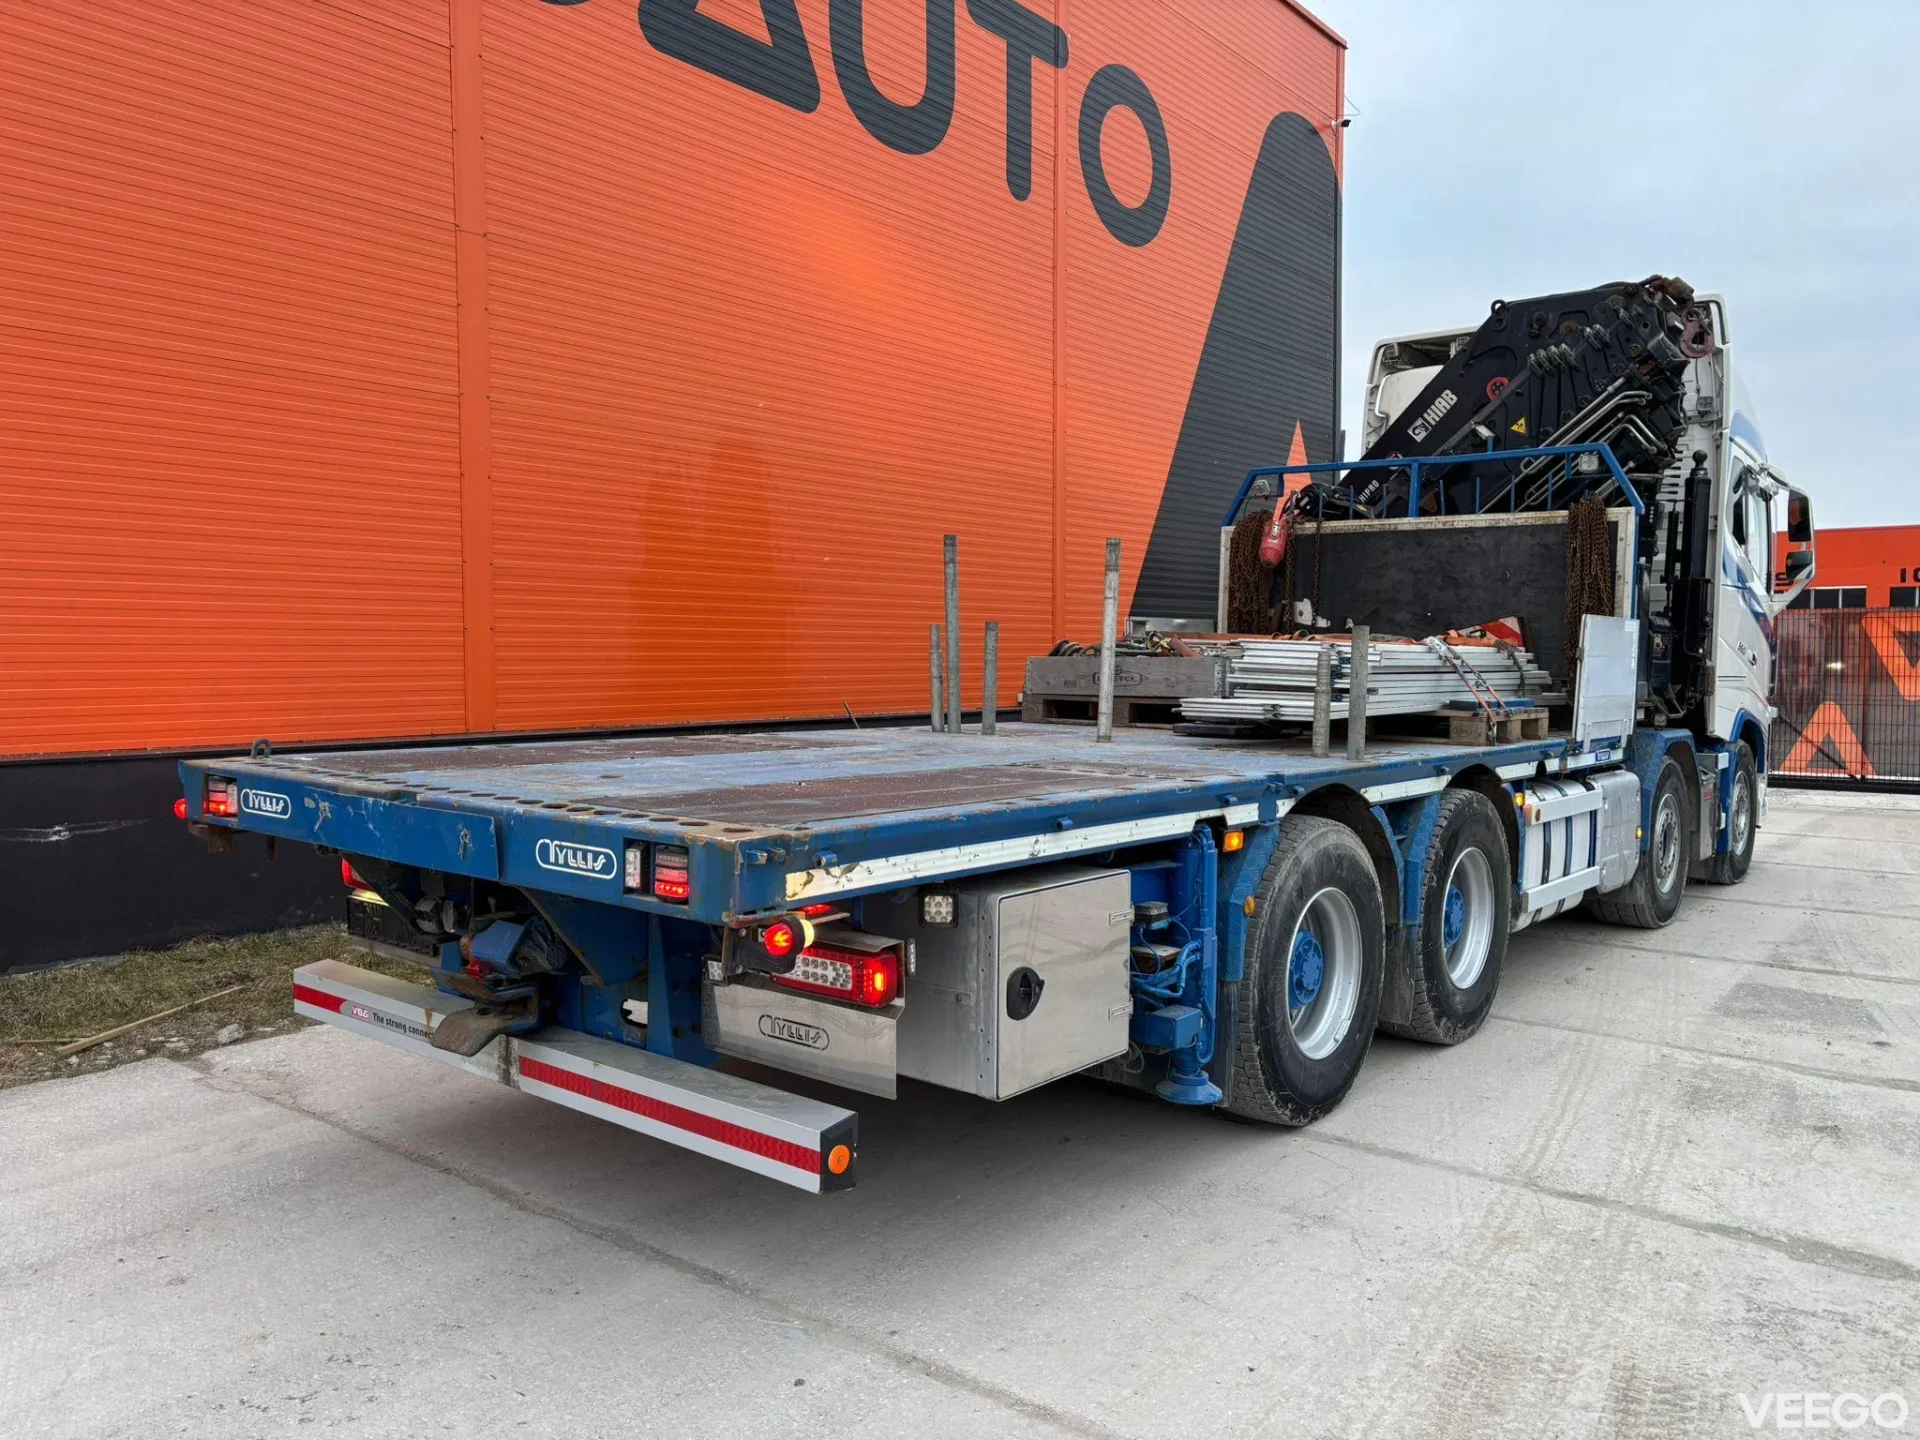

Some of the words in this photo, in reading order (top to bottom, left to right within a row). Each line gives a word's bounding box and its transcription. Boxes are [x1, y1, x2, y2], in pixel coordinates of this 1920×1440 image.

[1423, 389, 1458, 426] HIAB
[1358, 480, 1380, 503] HIPRO
[352, 1005, 369, 1019] VBG
[373, 1012, 384, 1024] The
[386, 1017, 407, 1033] strong
[408, 1025, 434, 1040] connec
